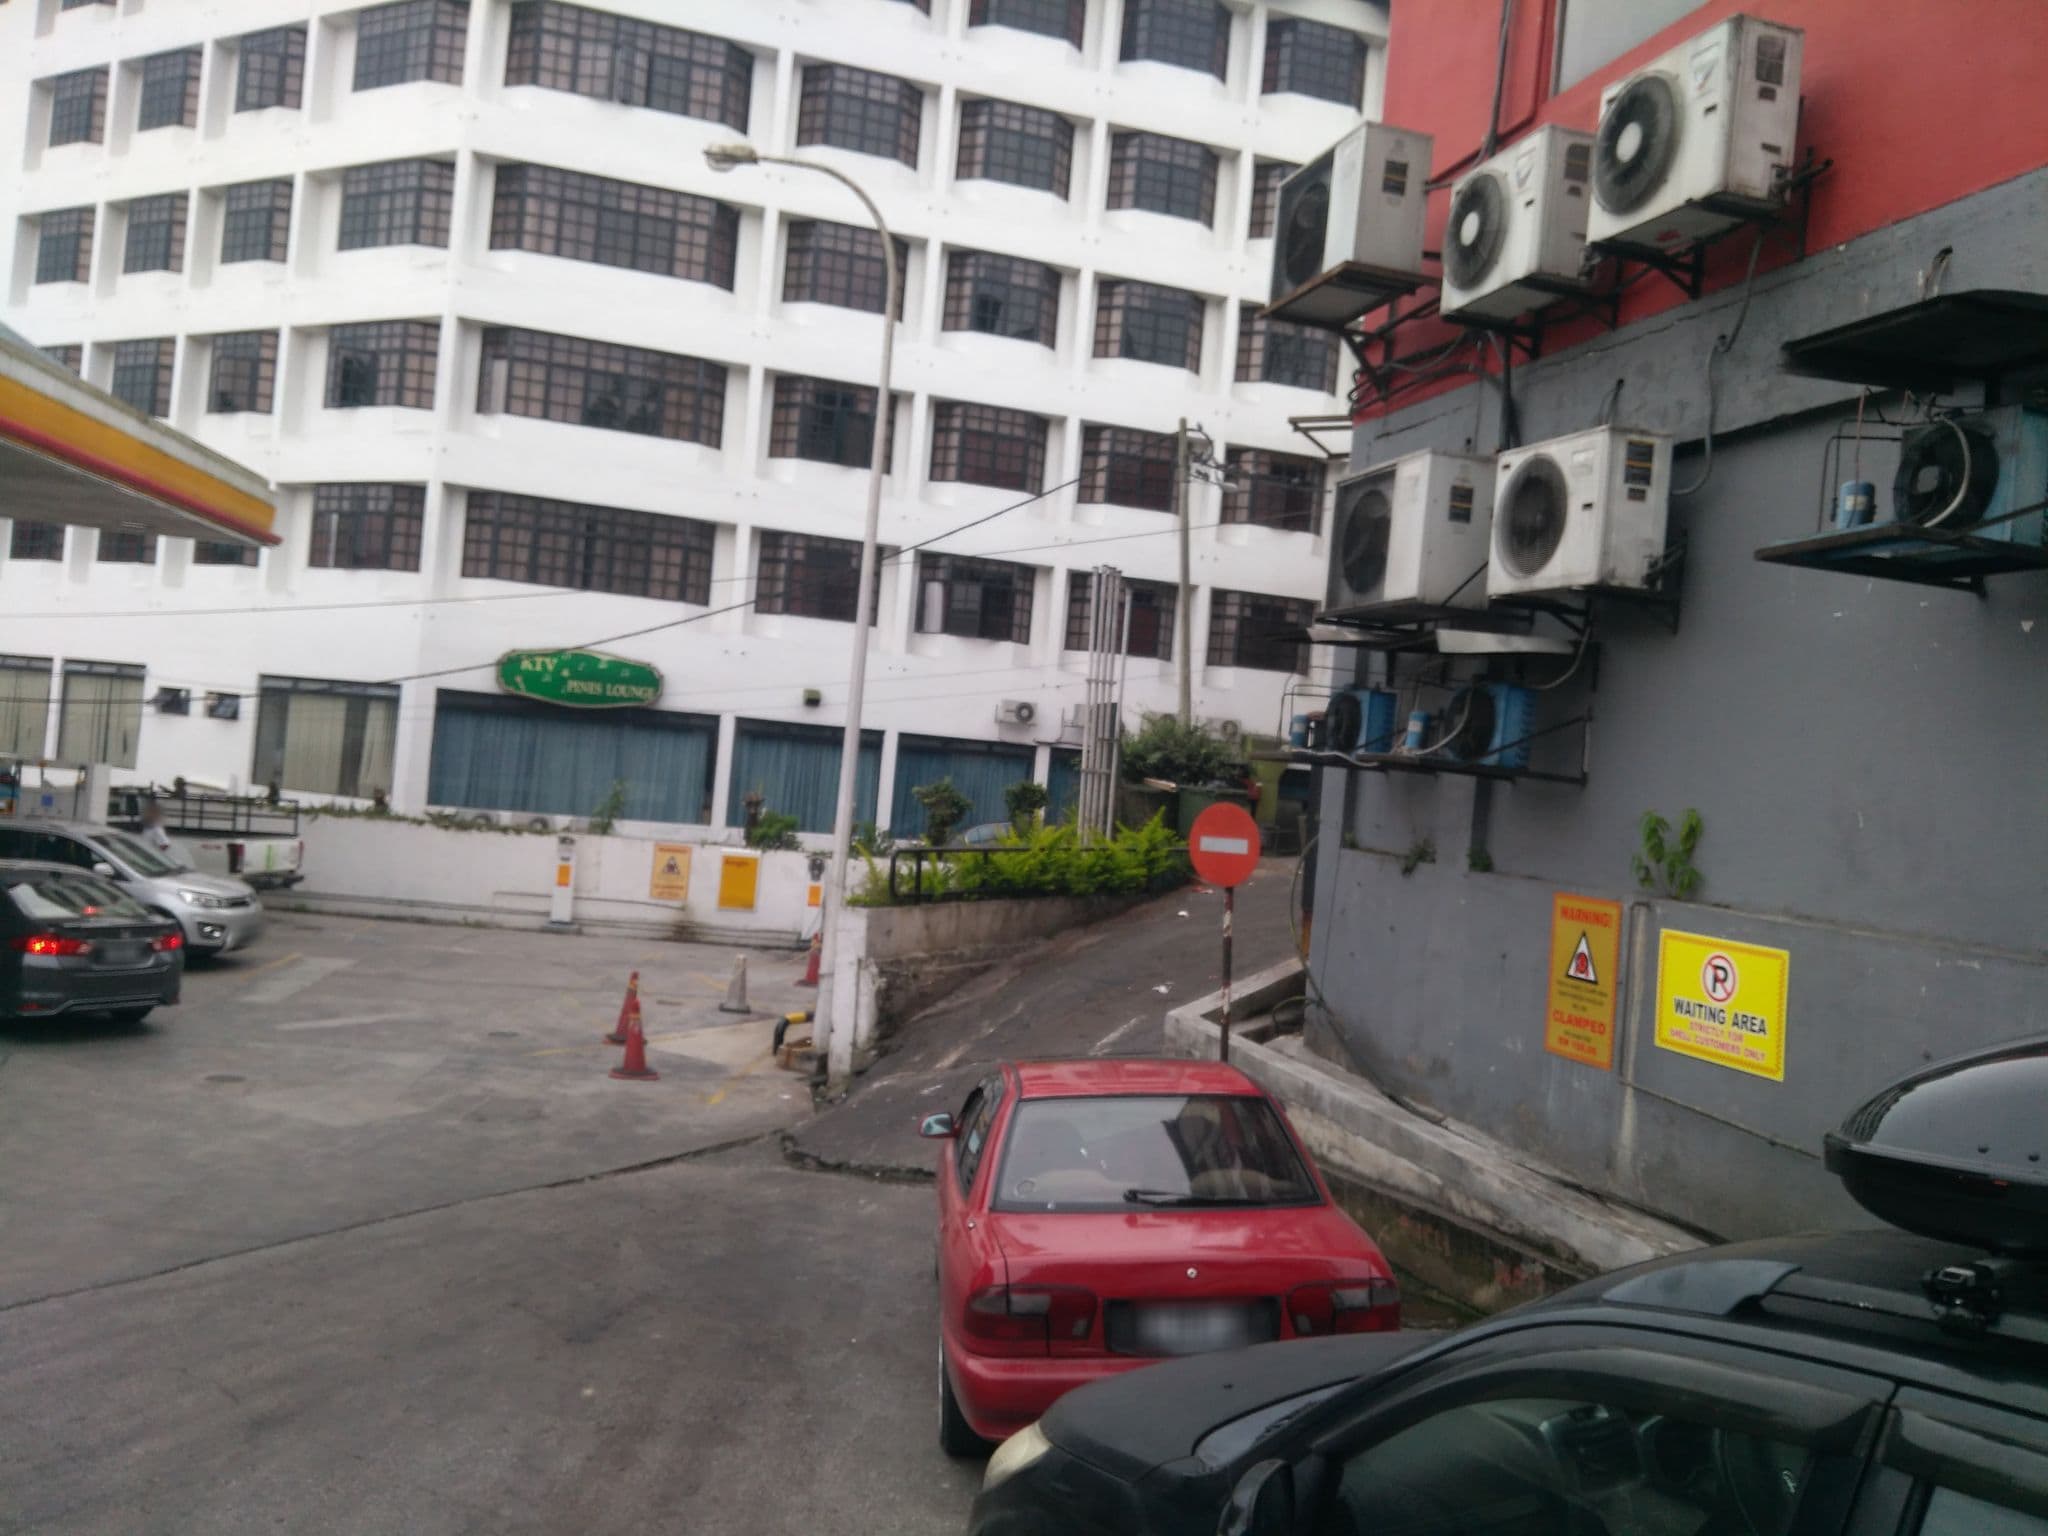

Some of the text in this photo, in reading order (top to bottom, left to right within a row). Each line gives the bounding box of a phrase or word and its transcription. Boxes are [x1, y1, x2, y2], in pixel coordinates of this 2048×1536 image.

[606, 683, 655, 700] LOUNGE
[1552, 1009, 1606, 1034] CLAMPED
[1674, 997, 1767, 1035] WAITING AREA
[1695, 1036, 1741, 1055] CUSTOMERS
[1744, 1048, 1765, 1061] ONLY
